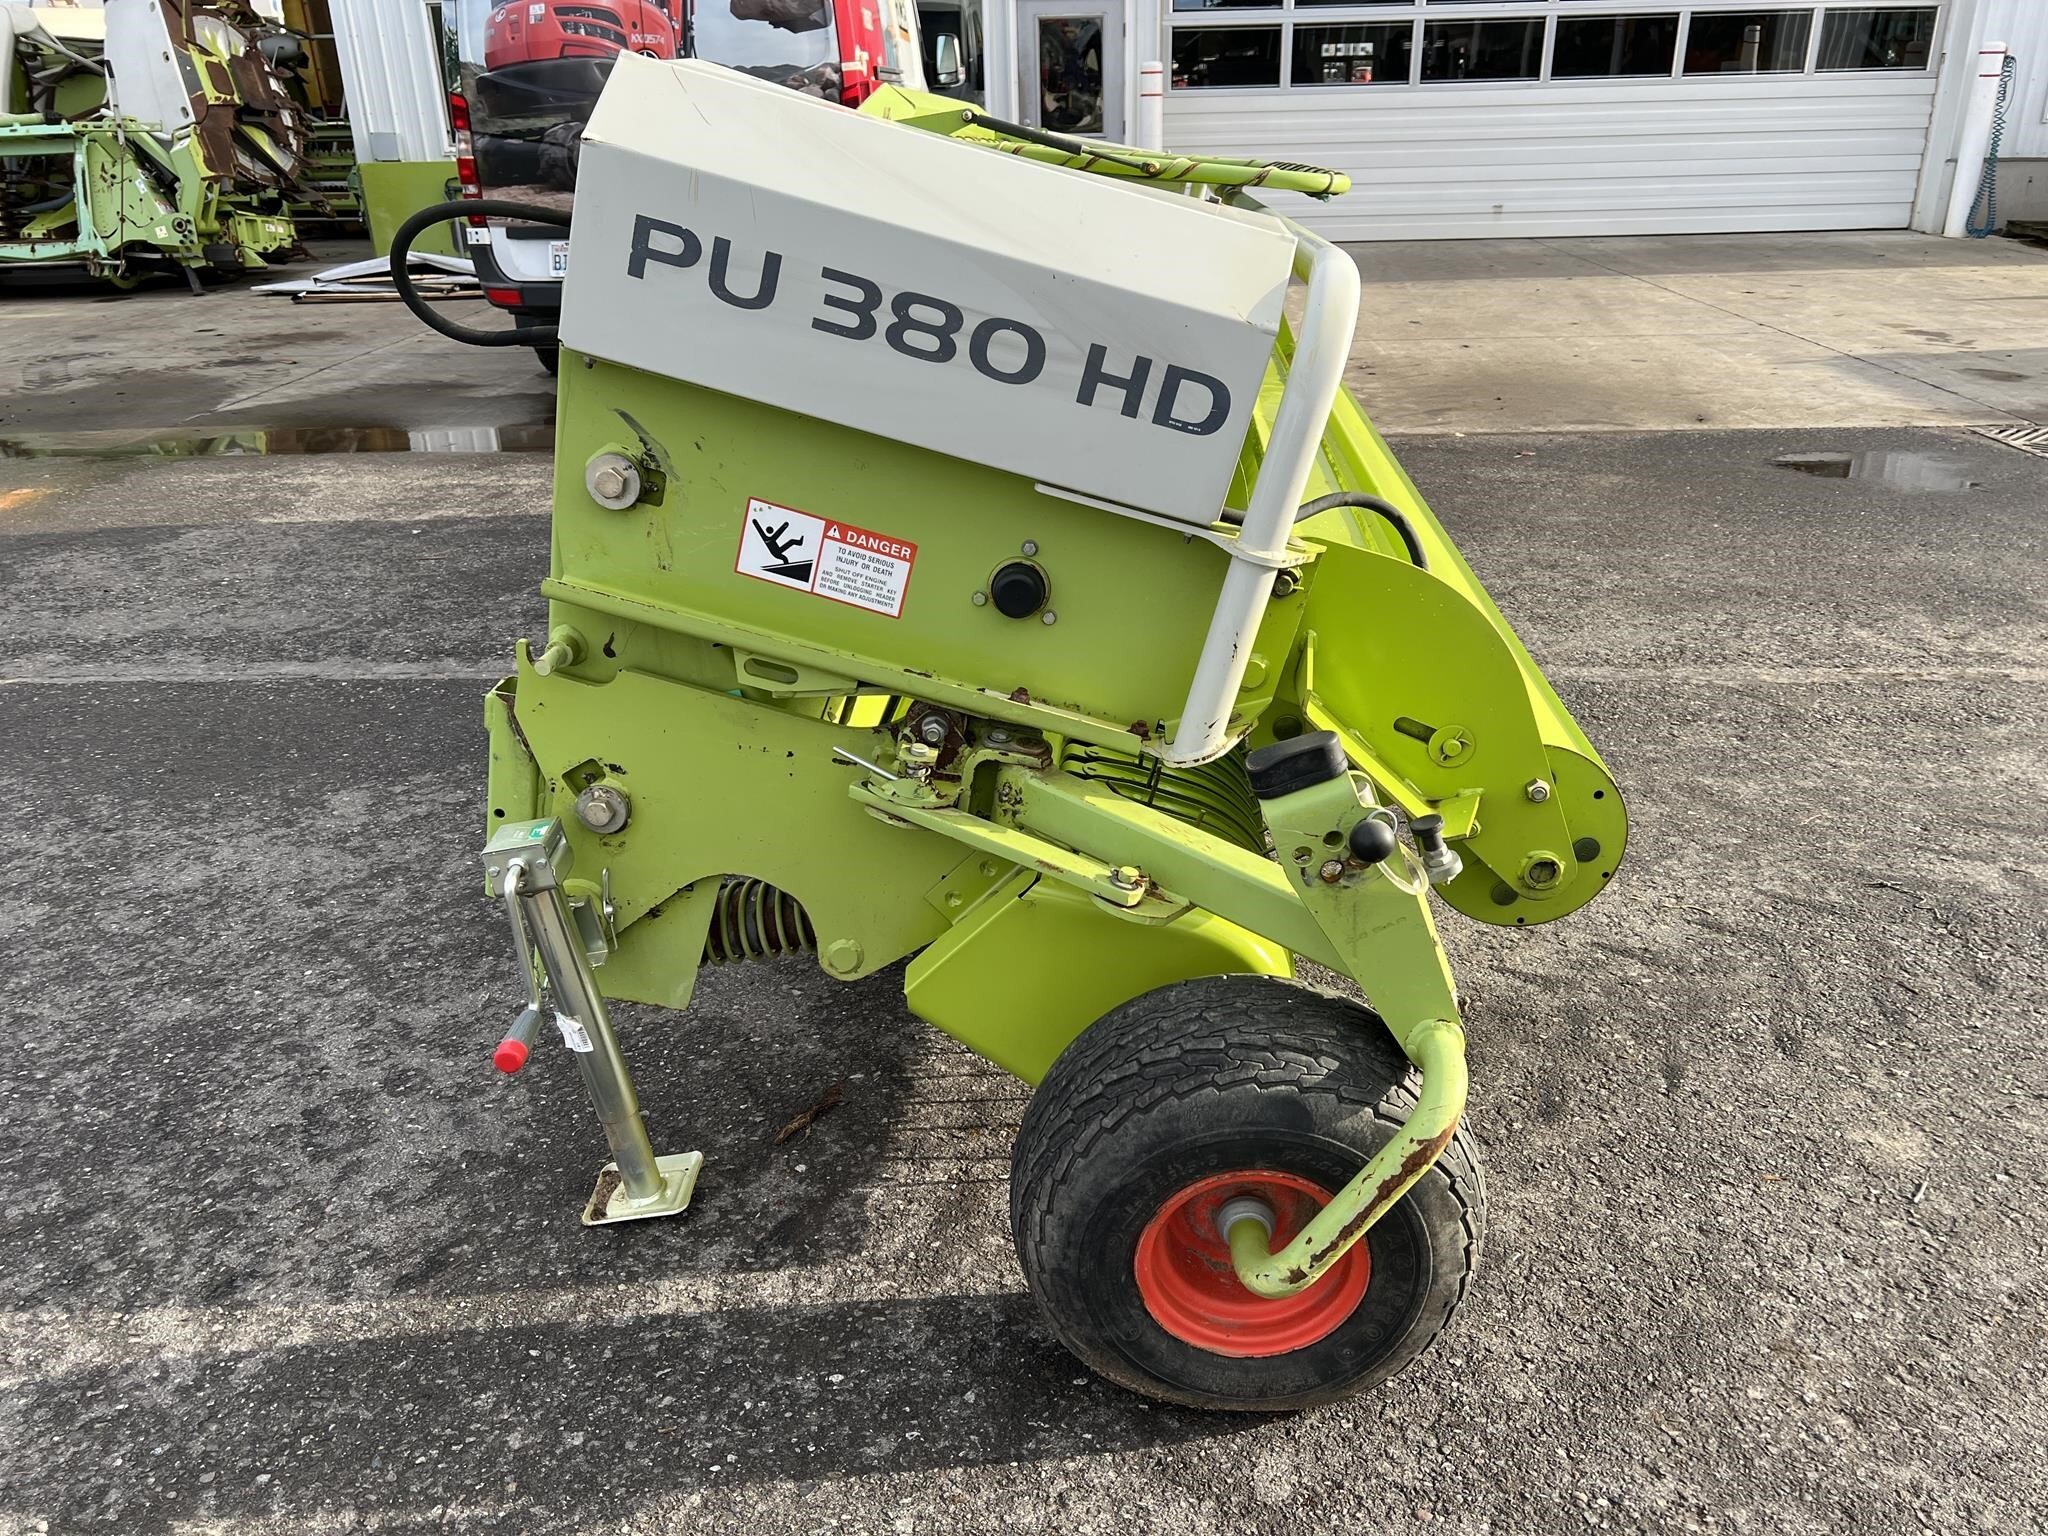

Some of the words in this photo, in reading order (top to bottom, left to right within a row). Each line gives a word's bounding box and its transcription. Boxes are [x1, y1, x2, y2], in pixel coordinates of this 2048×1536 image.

[626, 213, 783, 311] PU
[811, 265, 1047, 386] 380
[1076, 342, 1232, 437] HD
[846, 530, 911, 559] DANGER
[836, 555, 859, 567] INJURY
[861, 562, 871, 571] OR
[872, 566, 893, 577] DEATH
[838, 546, 847, 555] TO
[847, 550, 867, 561] AVOID
[867, 556, 895, 569] SERIOUS
[822, 569, 833, 577] AND
[836, 574, 858, 584] REMOVE
[861, 581, 884, 591] STARTER
[835, 566, 851, 575] SHUT
[852, 571, 864, 579] OFF
[865, 574, 887, 586] ENGINE
[820, 576, 840, 586] BEFORE
[876, 591, 896, 602] HEADER
[827, 585, 847, 595] MAKING
[847, 591, 858, 599] ANY
[858, 594, 894, 609] ADJUSTMENTS
